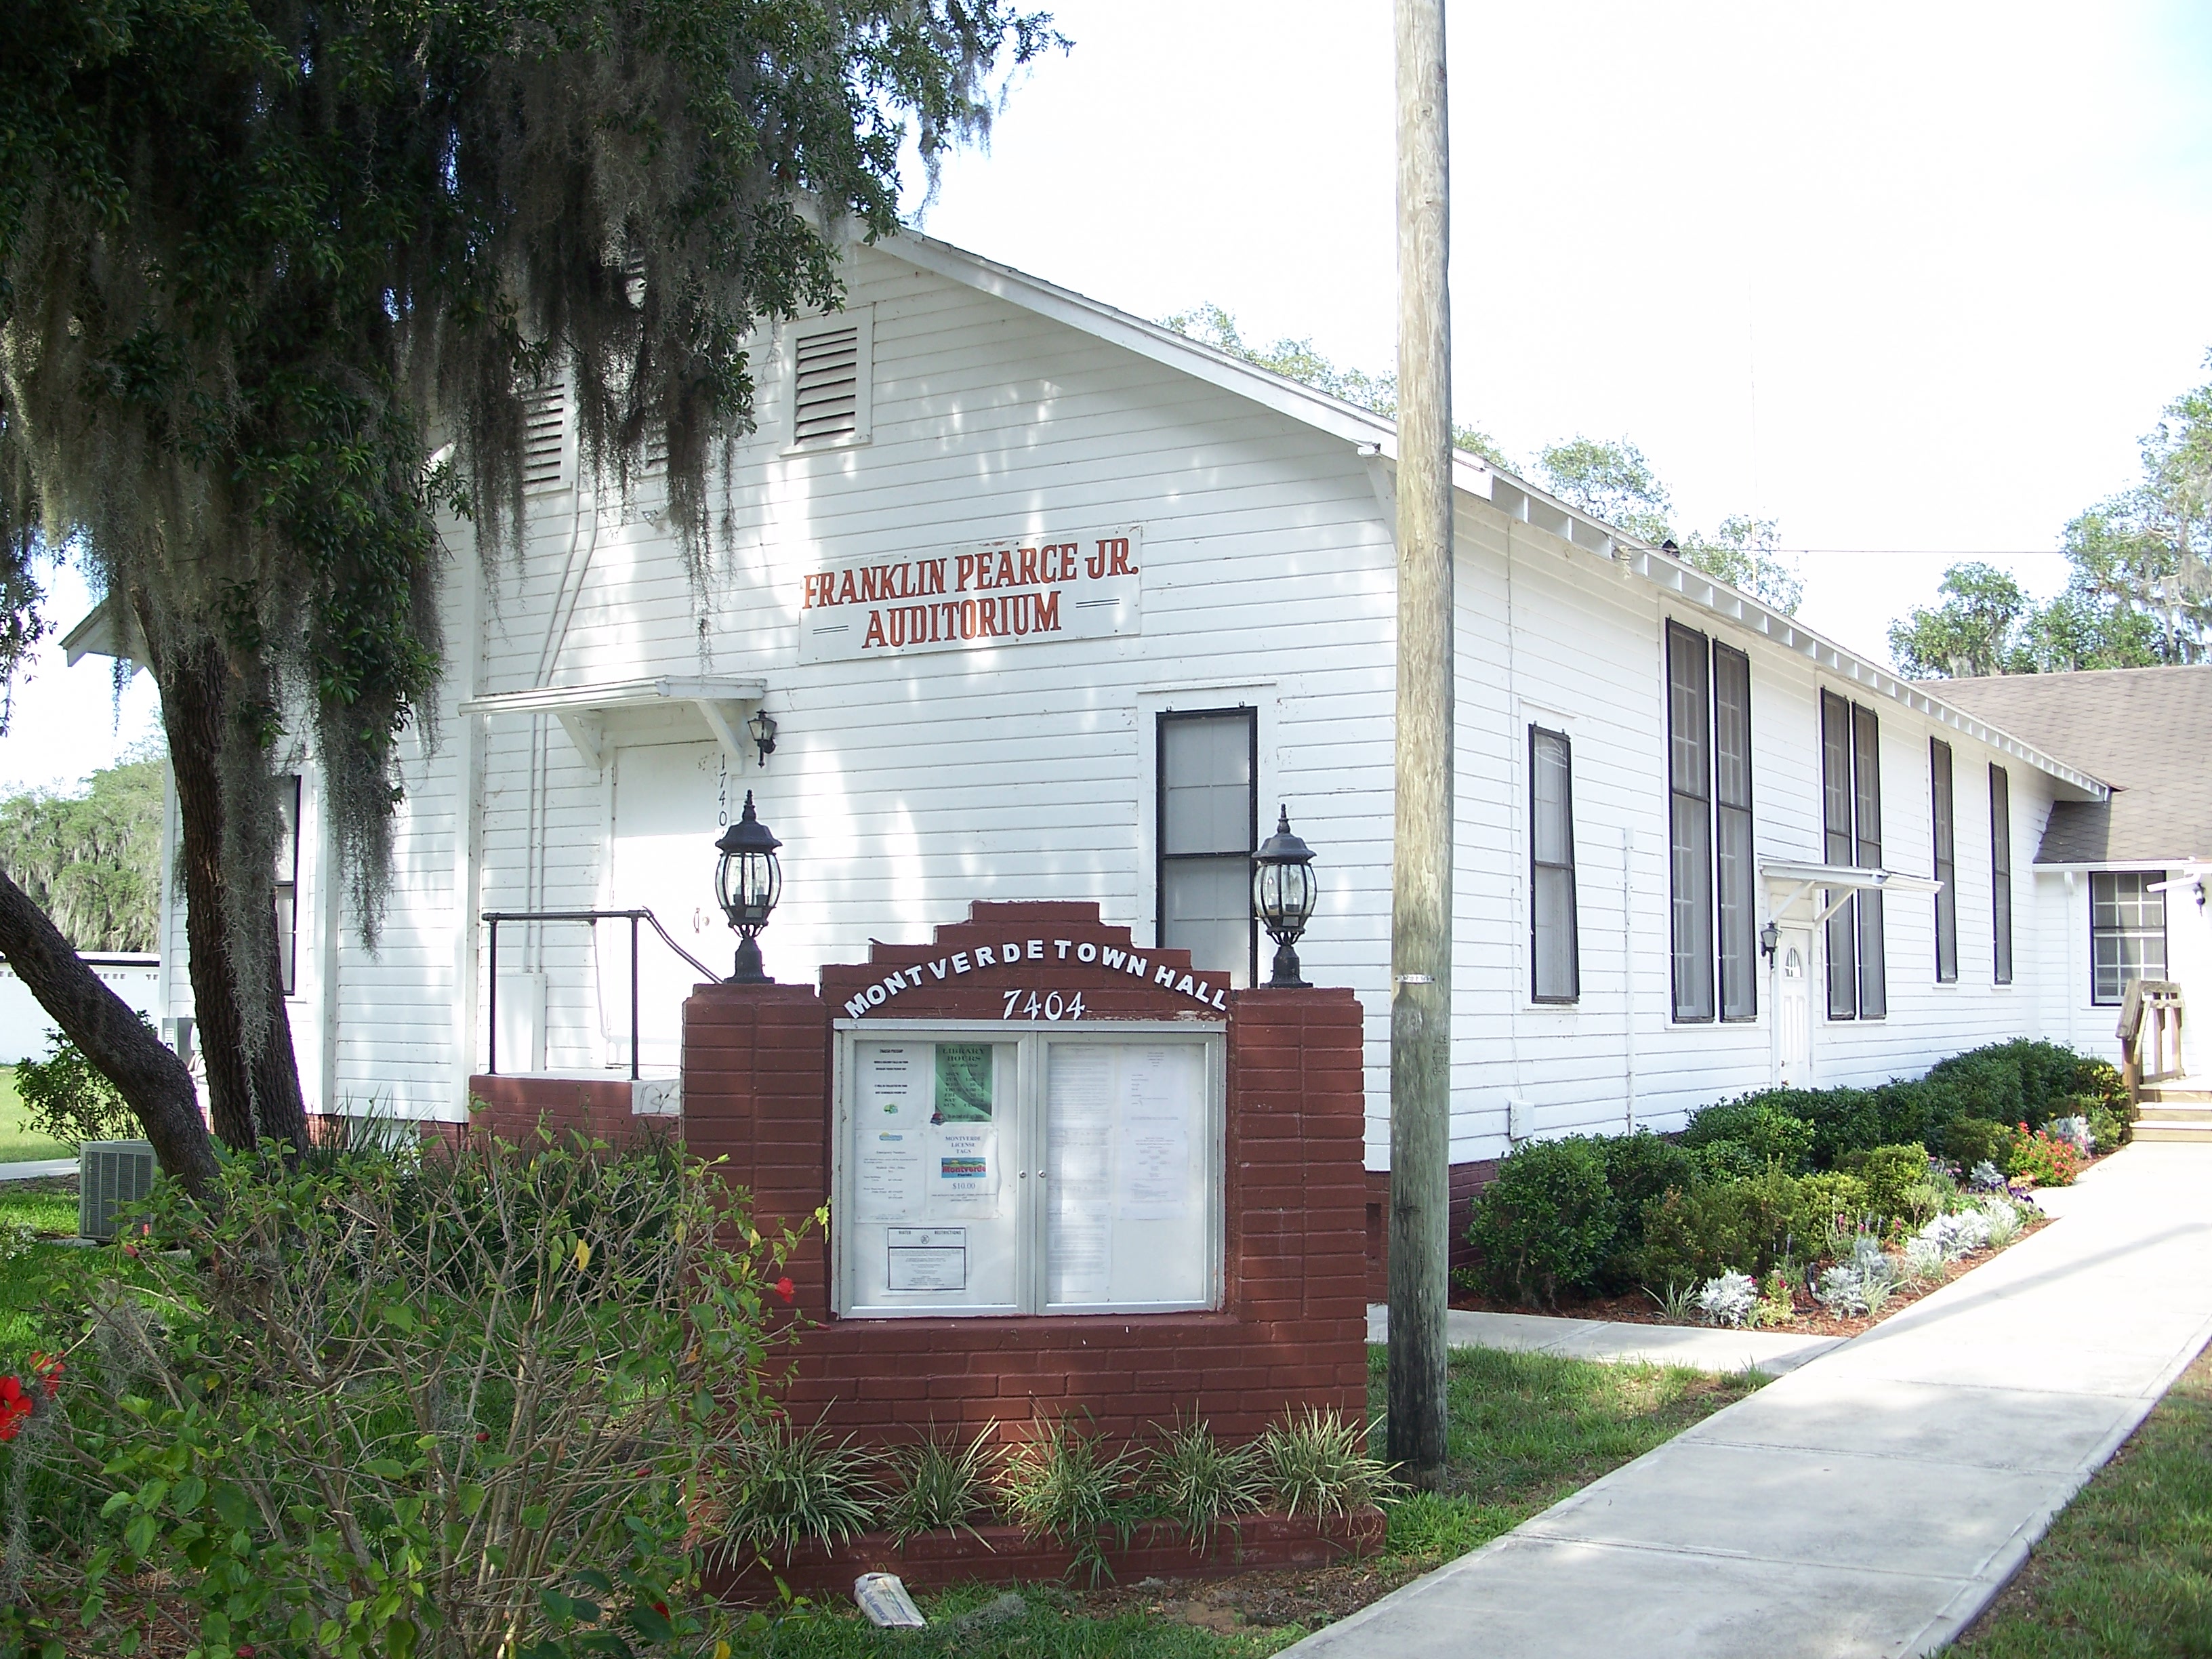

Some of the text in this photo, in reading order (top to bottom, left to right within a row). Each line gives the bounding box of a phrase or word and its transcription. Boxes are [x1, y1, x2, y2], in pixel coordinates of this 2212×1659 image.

[802, 537, 1139, 610] FRANKLIN PEARCE JR.
[861, 590, 1062, 649] AUDITORIUM
[718, 752, 728, 836] 1740
[844, 939, 1227, 1019] MONTVERDE TOWN HALL
[1002, 989, 1086, 1021] 7404
[952, 1182, 976, 1190] $10.00
